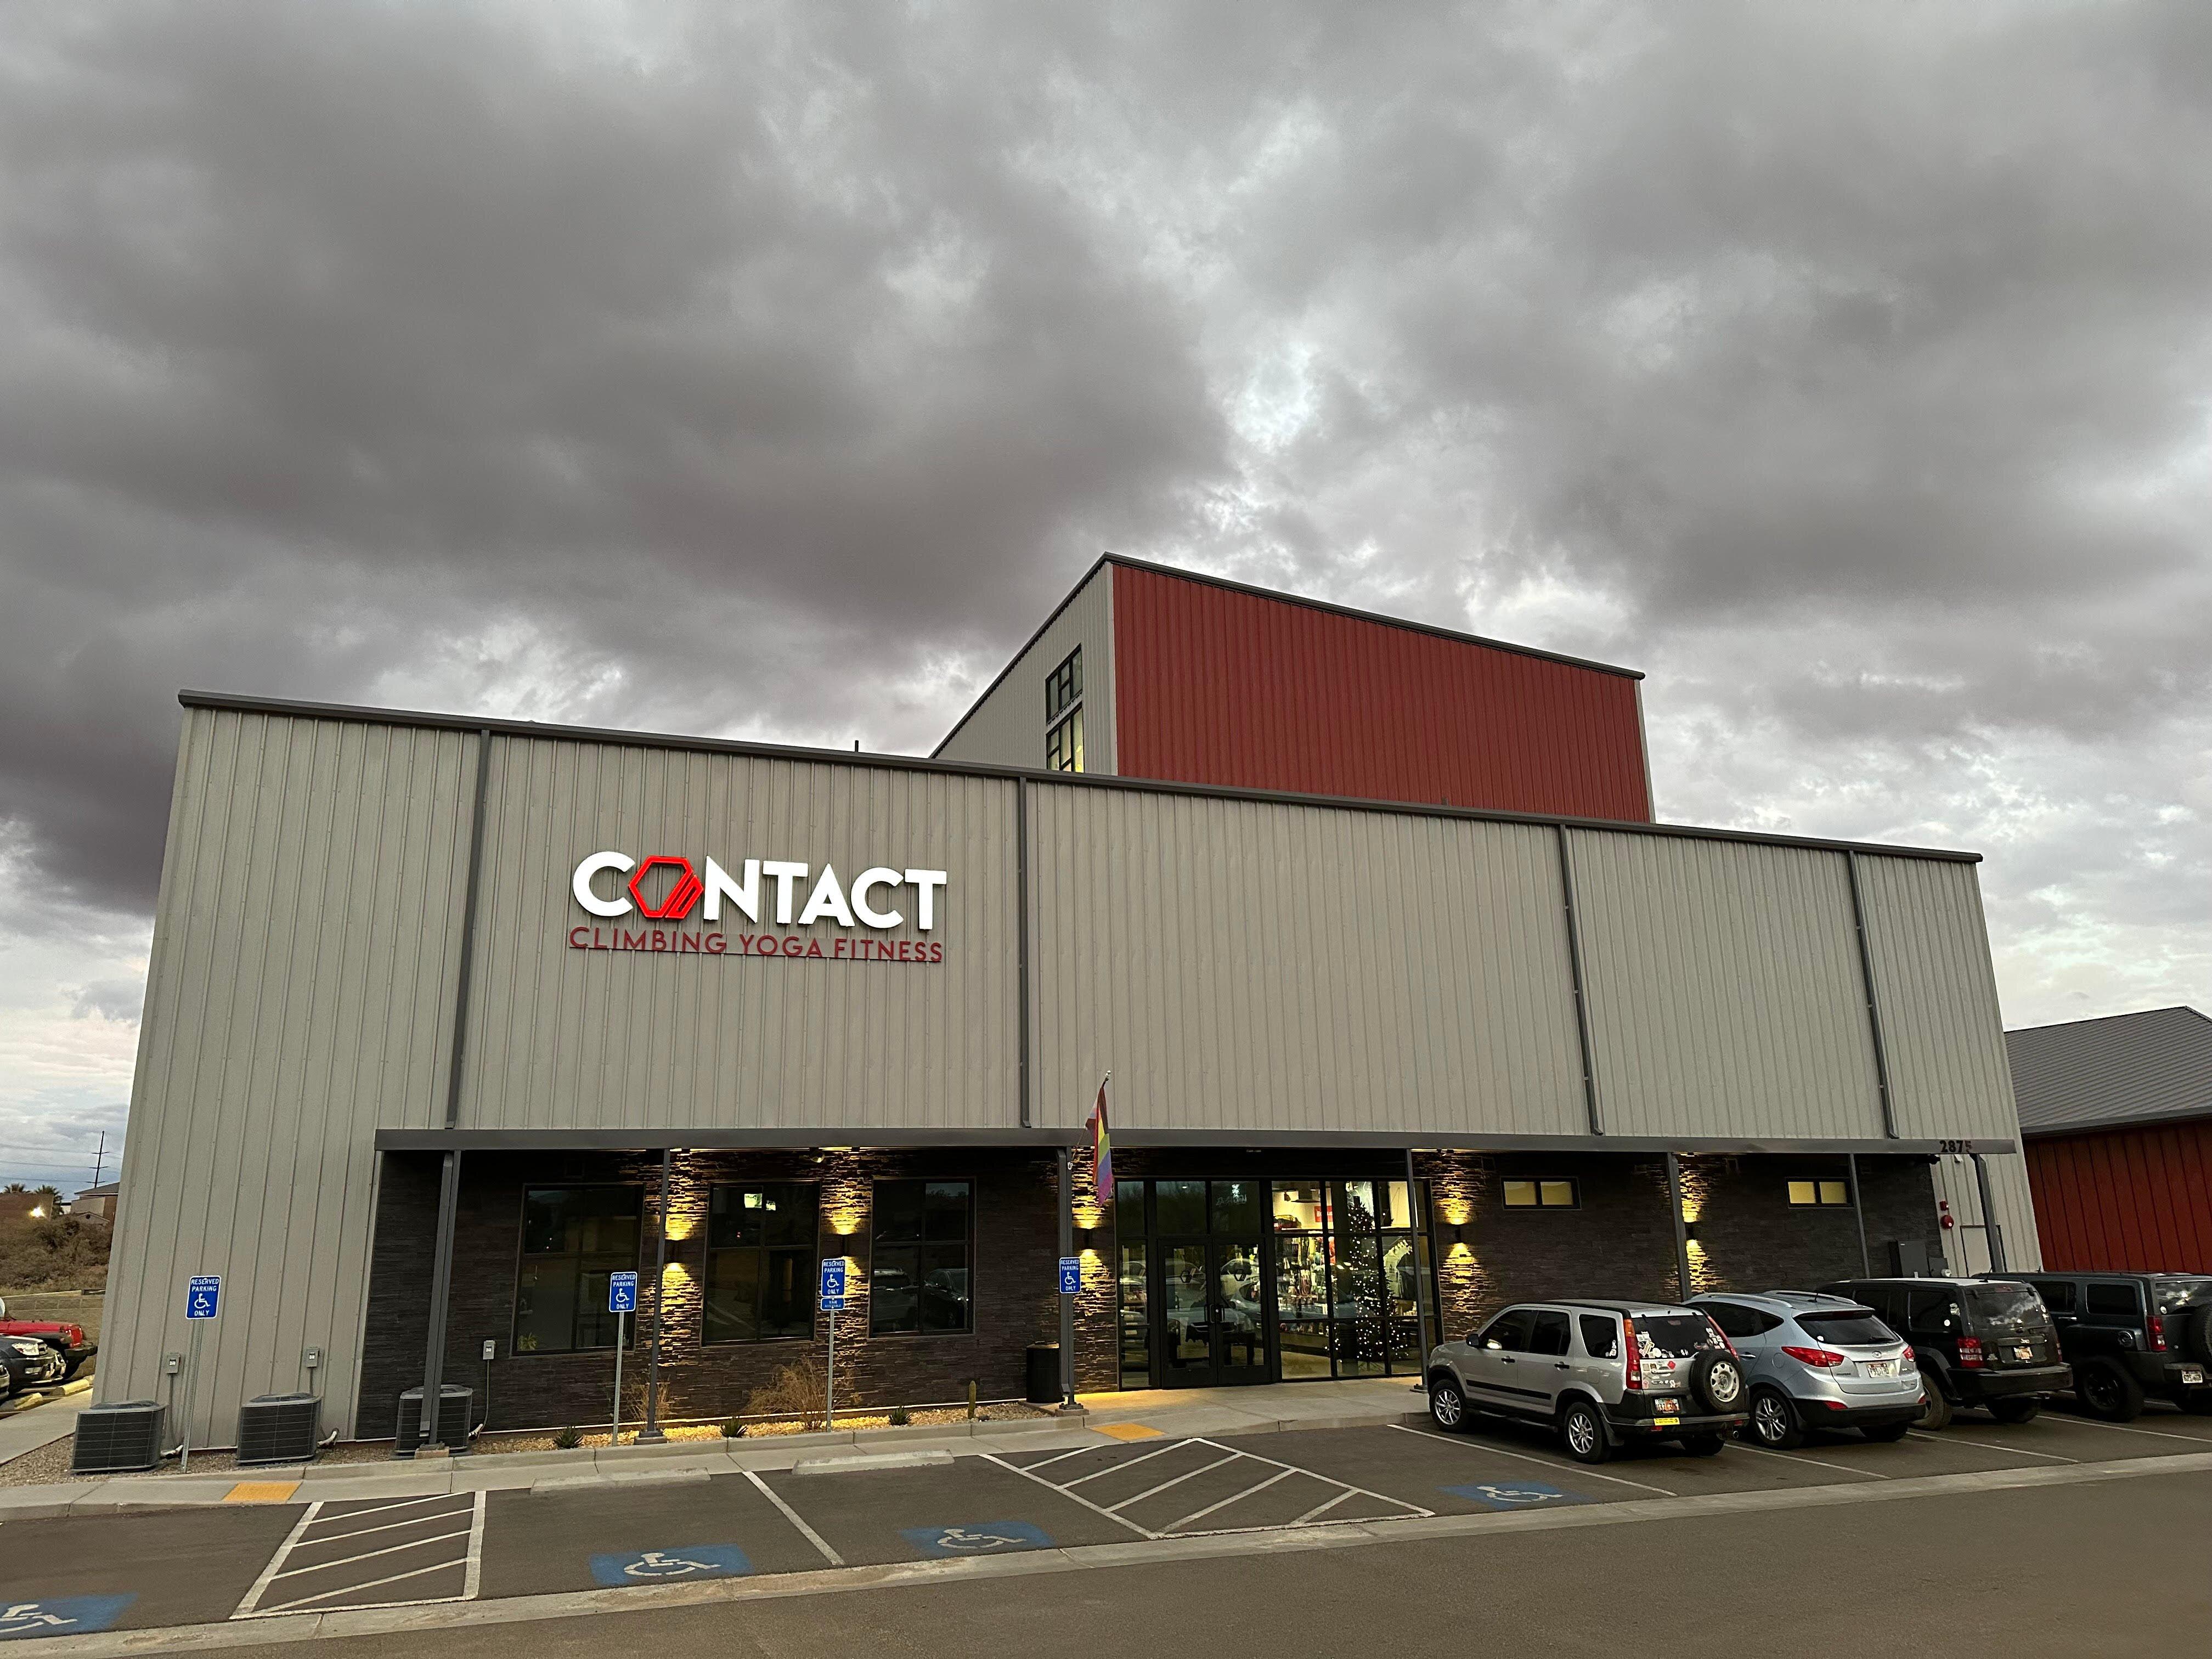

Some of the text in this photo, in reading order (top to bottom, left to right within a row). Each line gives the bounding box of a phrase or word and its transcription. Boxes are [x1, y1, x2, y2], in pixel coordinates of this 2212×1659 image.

[573, 851, 947, 930] CONTACT
[569, 927, 943, 962] CLIMBING YOGA FITNESS
[1939, 1140, 1972, 1153] 2875
